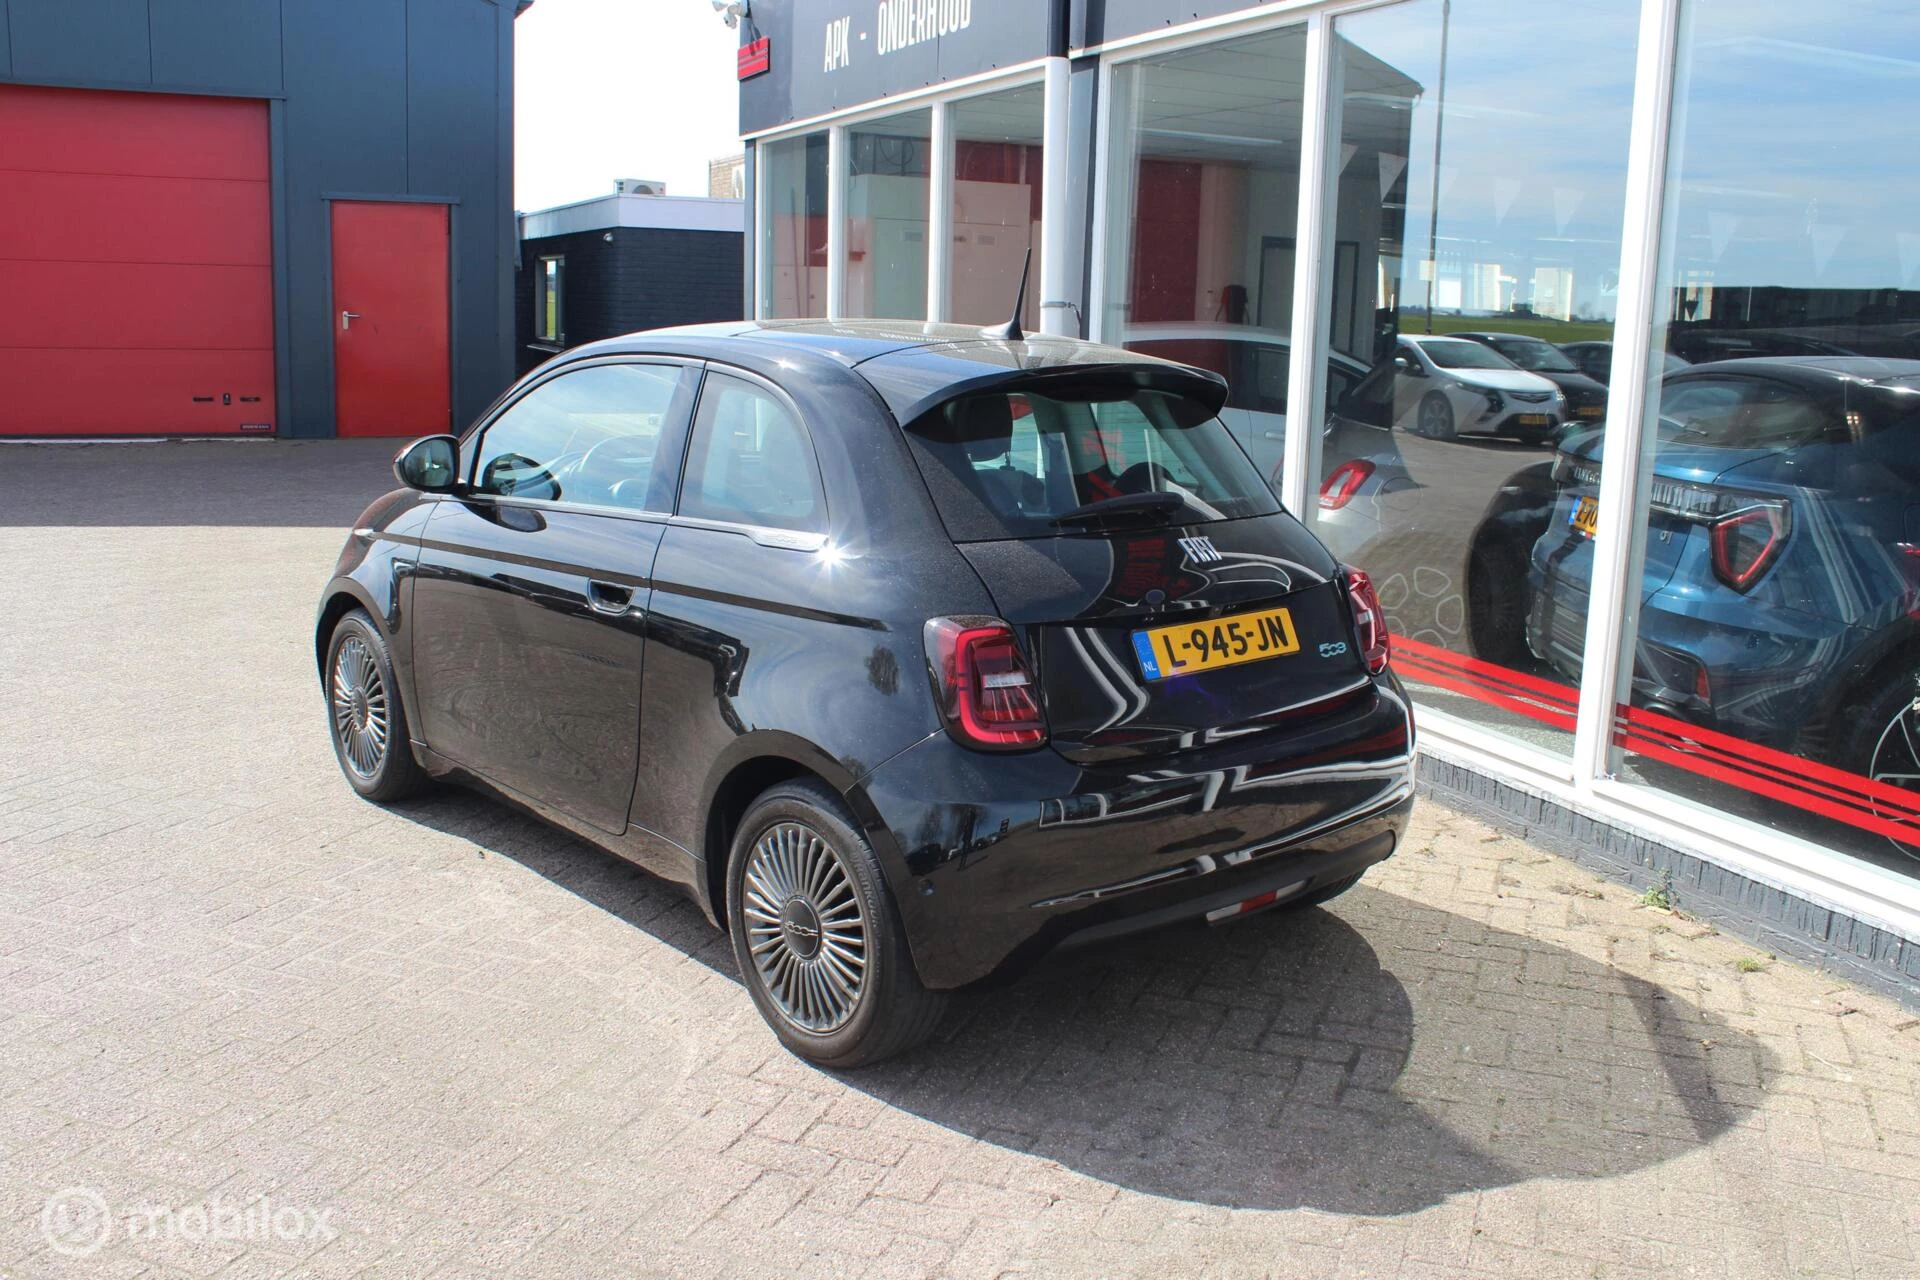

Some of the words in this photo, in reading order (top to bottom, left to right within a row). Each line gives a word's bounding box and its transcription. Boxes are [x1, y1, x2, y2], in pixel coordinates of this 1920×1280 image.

[824, 16, 850, 72] APK
[878, 0, 971, 55] ONDERHOUD
[1177, 535, 1223, 564] FIAT
[1162, 615, 1289, 668] L-945-JN
[1143, 661, 1157, 672] NL
